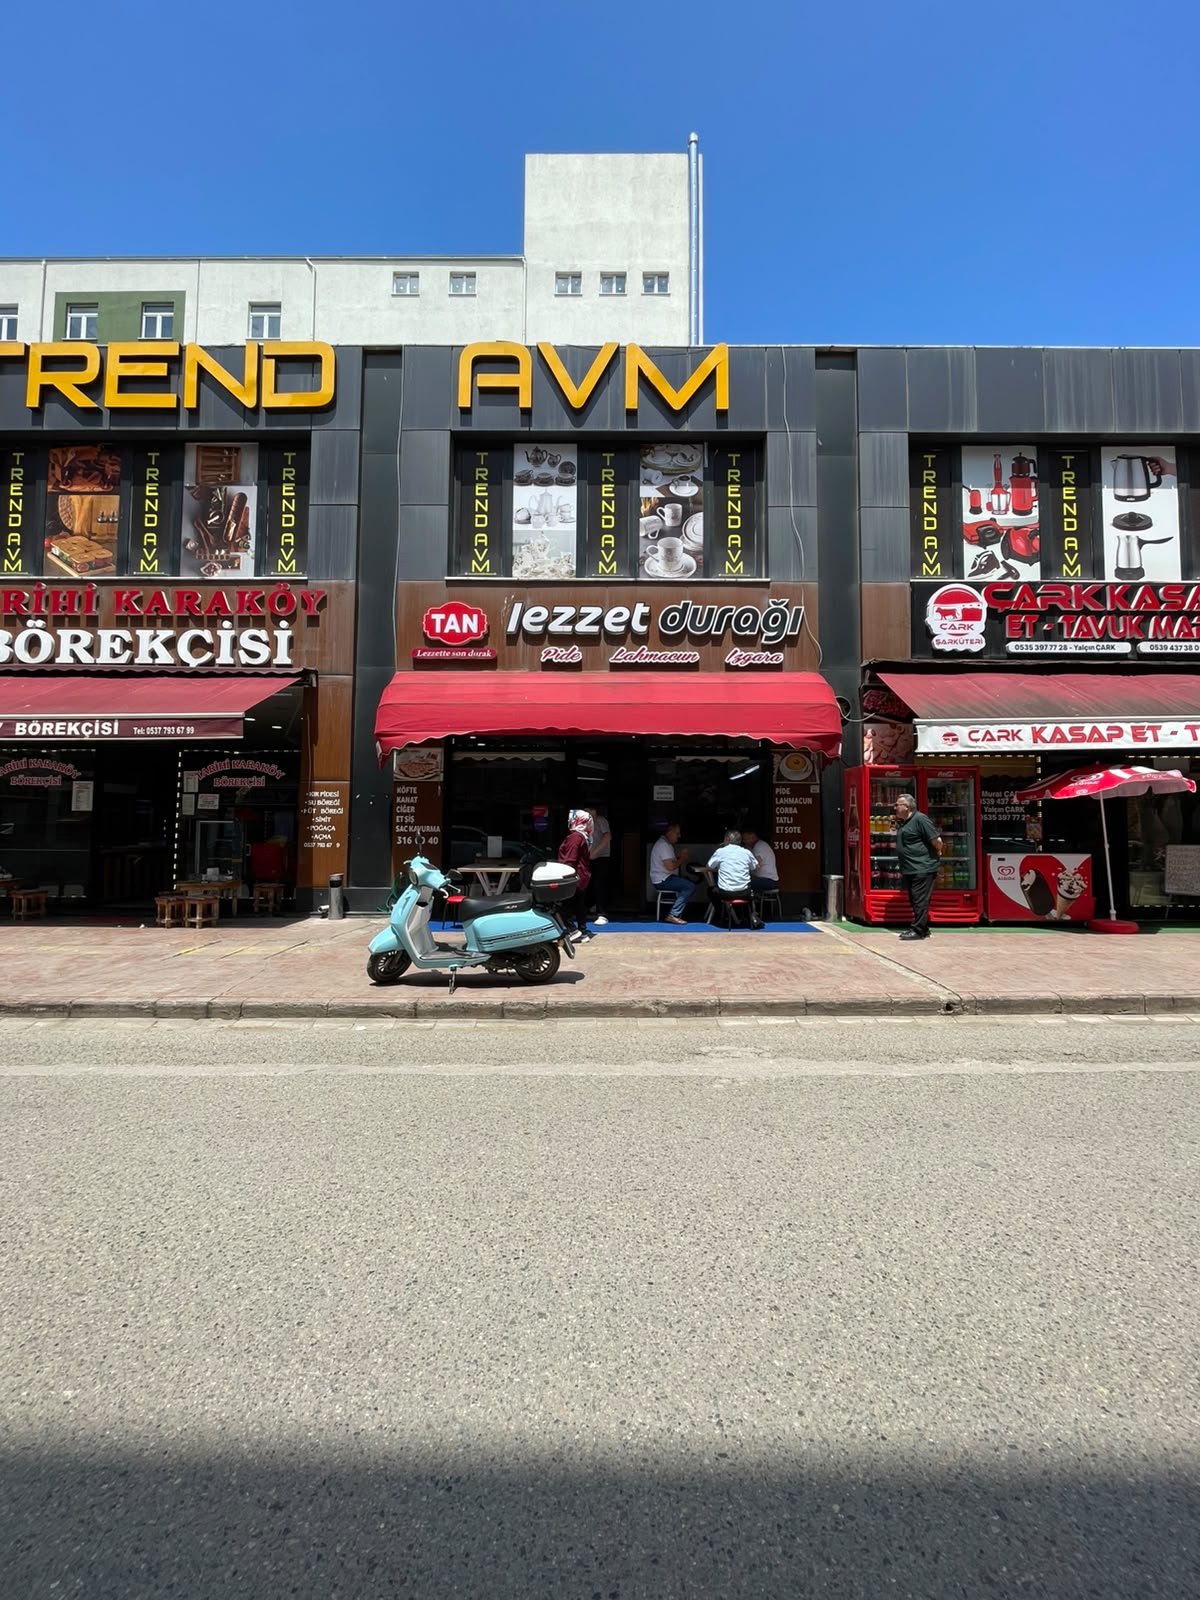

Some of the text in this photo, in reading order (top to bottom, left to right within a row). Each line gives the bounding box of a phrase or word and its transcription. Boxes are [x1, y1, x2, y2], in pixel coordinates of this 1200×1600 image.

[458, 342, 729, 410] AVM
[8, 452, 25, 527] TREND
[144, 452, 160, 527] TREND
[282, 452, 297, 527] TREND
[474, 452, 489, 528] TREND
[601, 453, 615, 529] TREND
[727, 454, 741, 529] TREND
[923, 455, 938, 530] TREND
[1061, 455, 1081, 577] TREND AVM
[2, 532, 22, 572] AVM
[139, 532, 159, 572] AVM
[277, 532, 297, 572] AVM
[471, 533, 490, 573] AVM
[598, 535, 617, 574] AVM
[725, 535, 744, 574] AVM
[922, 536, 941, 576] AVM
[112, 582, 327, 616] KARAKÖY
[983, 583, 1104, 613] ÇARK
[431, 613, 479, 634] TAN
[506, 598, 805, 644] lezzet durağı
[1006, 615, 1040, 638] ET
[1057, 615, 1145, 639] TAVUK
[416, 649, 451, 657] Lezzette
[468, 649, 492, 657] durak
[935, 637, 983, 646] ŞARKÜTERİ
[1073, 644, 1095, 652] Yalçın
[1095, 643, 1116, 652] ÇARK
[540, 645, 583, 663] Pide
[609, 645, 700, 664] Lahmacun
[725, 647, 784, 667] Izgara
[15, 720, 119, 738] BÖREKÇİSİ
[133, 727, 145, 735] Tel:
[146, 727, 162, 735] 0537
[176, 726, 185, 734] 67
[186, 726, 195, 734] 99
[968, 729, 1024, 744] ÇARK
[1031, 725, 1124, 744] KASAP
[1130, 725, 1162, 742] ET
[28, 758, 82, 779] KARAKÖY
[195, 758, 286, 781] TARİHİ KARAKÖY
[10, 774, 62, 788] BÖREKÇİSİ
[213, 775, 266, 788] BÖREKÇİSİ
[396, 785, 417, 794] KÖFTE
[775, 786, 791, 795] PİDE
[396, 815, 404, 823] ET
[775, 807, 798, 815] ÇORBA
[983, 806, 1025, 814] Yalçın ÇARK
[396, 836, 412, 845] 316
[428, 836, 439, 845] 40
[773, 841, 816, 849] 316 00 40
